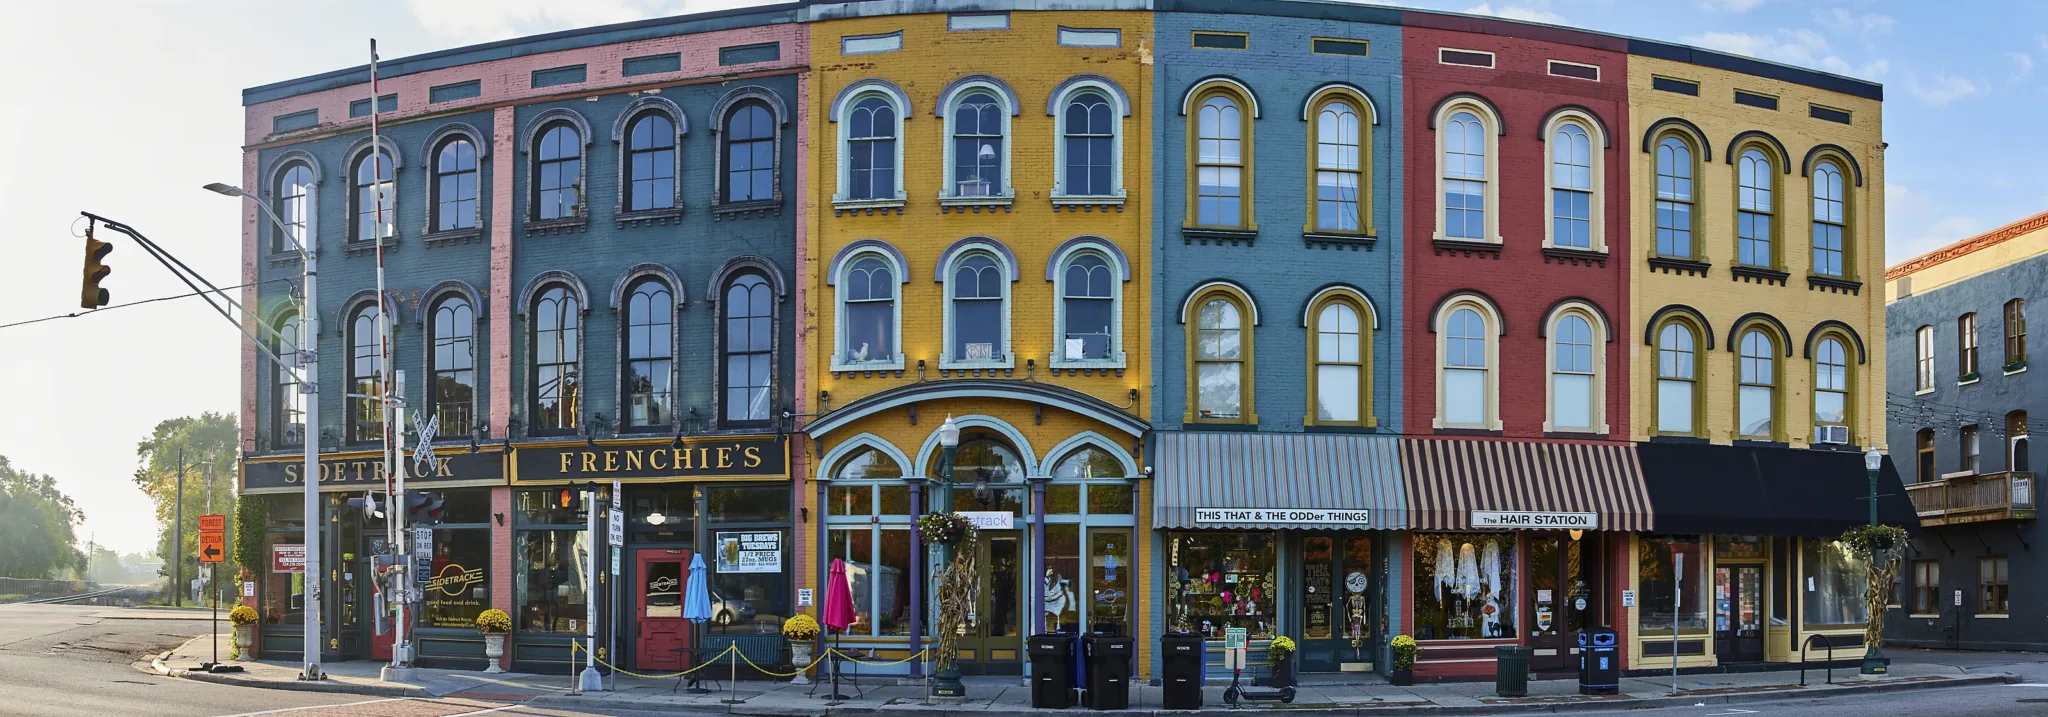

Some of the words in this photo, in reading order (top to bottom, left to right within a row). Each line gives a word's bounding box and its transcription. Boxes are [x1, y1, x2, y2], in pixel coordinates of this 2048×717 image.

[415, 417, 438, 463] CROSSING
[559, 443, 762, 473] FRENCHIE'S
[284, 456, 454, 484] SDETRACK
[613, 514, 620, 522] NO
[1197, 511, 1221, 520] THIS
[1224, 511, 1251, 520] THAT
[1254, 511, 1263, 520] &
[1266, 511, 1286, 520] THE
[1289, 511, 1324, 521] ODDer
[1327, 512, 1367, 521] THINGS
[1500, 515, 1530, 524] HAIR
[1534, 515, 1587, 525] STATION
[202, 519, 222, 527] FOREST
[201, 535, 222, 544] DETOUR
[416, 530, 432, 540] STOP
[741, 534, 752, 542] BIG
[742, 542, 777, 550] TUESDAYS
[432, 573, 475, 587] SIDETRACK
